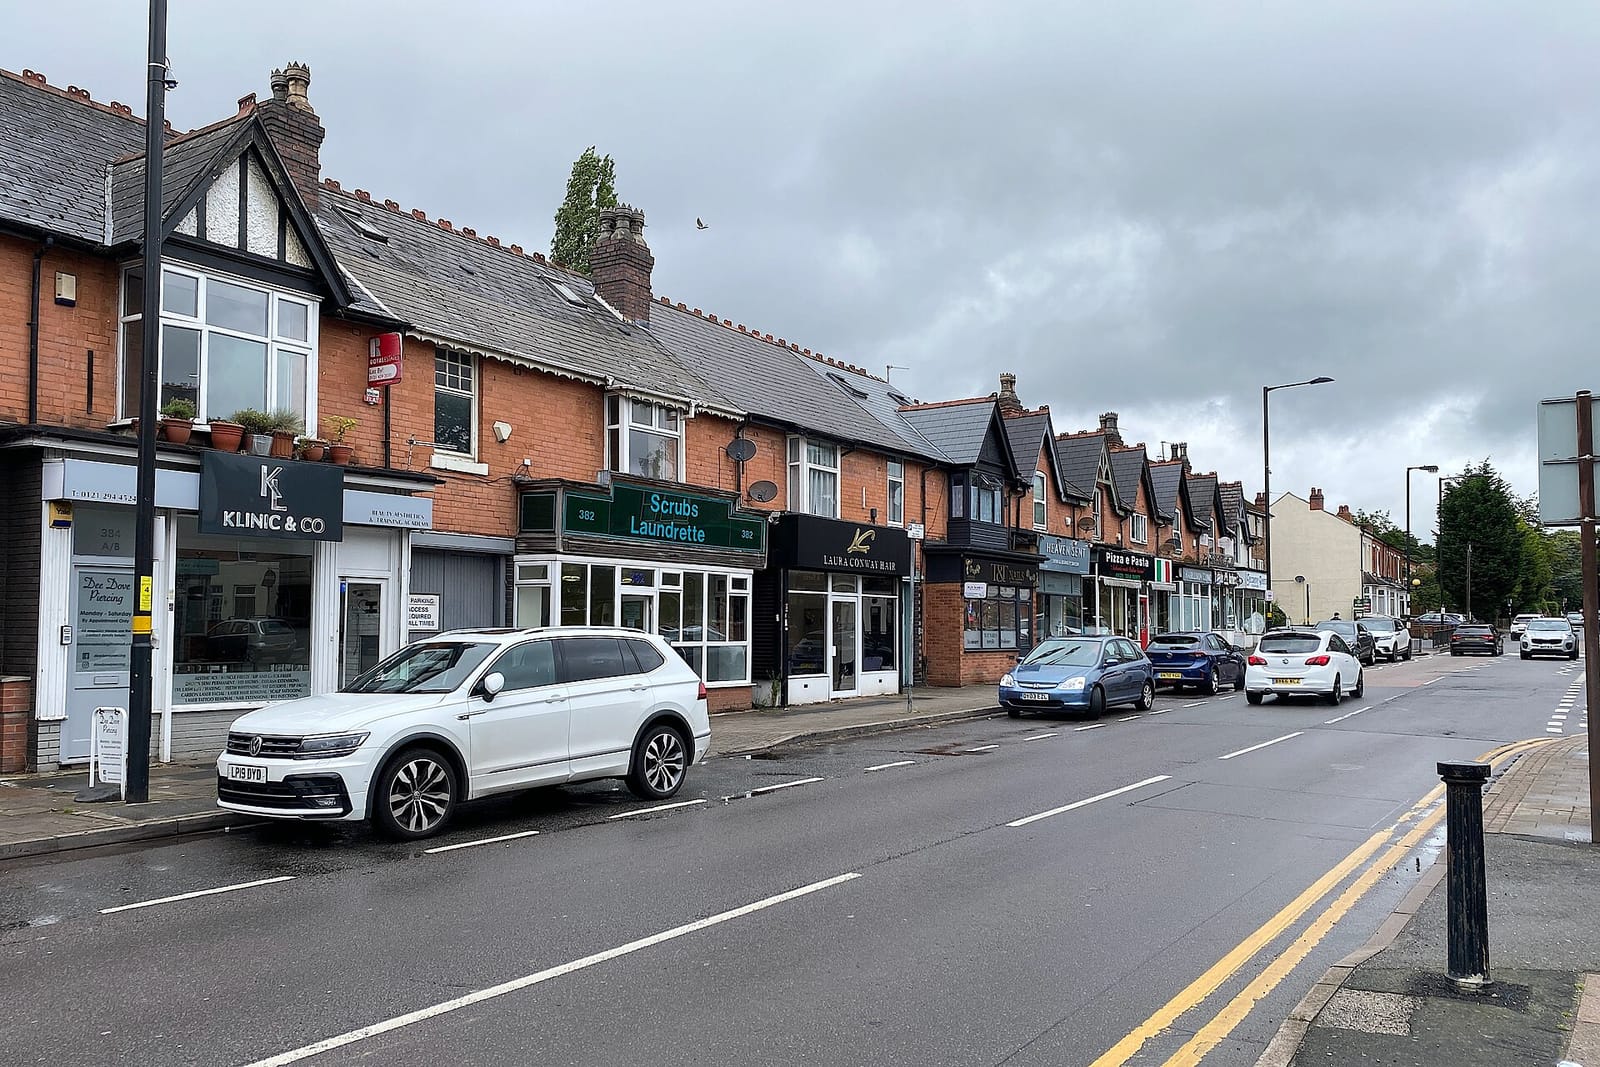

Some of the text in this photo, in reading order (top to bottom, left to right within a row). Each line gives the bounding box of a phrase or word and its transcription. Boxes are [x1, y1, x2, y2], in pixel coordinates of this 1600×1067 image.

[81, 490, 100, 499] 0121
[650, 493, 699, 518] Scrubs
[223, 510, 326, 534] KLINIC & CO
[578, 509, 595, 521] 382
[630, 515, 706, 543] Laundrette
[741, 529, 754, 540] 382
[1046, 542, 1070, 557] HEAVEN
[824, 554, 896, 571] LAURA CONWAY HAIR
[1106, 552, 1150, 568] Pizza e Pasta
[83, 576, 104, 590] Dee
[106, 577, 131, 590] Dove
[89, 589, 124, 606] Piercing
[231, 766, 262, 780] LP19 DYD
